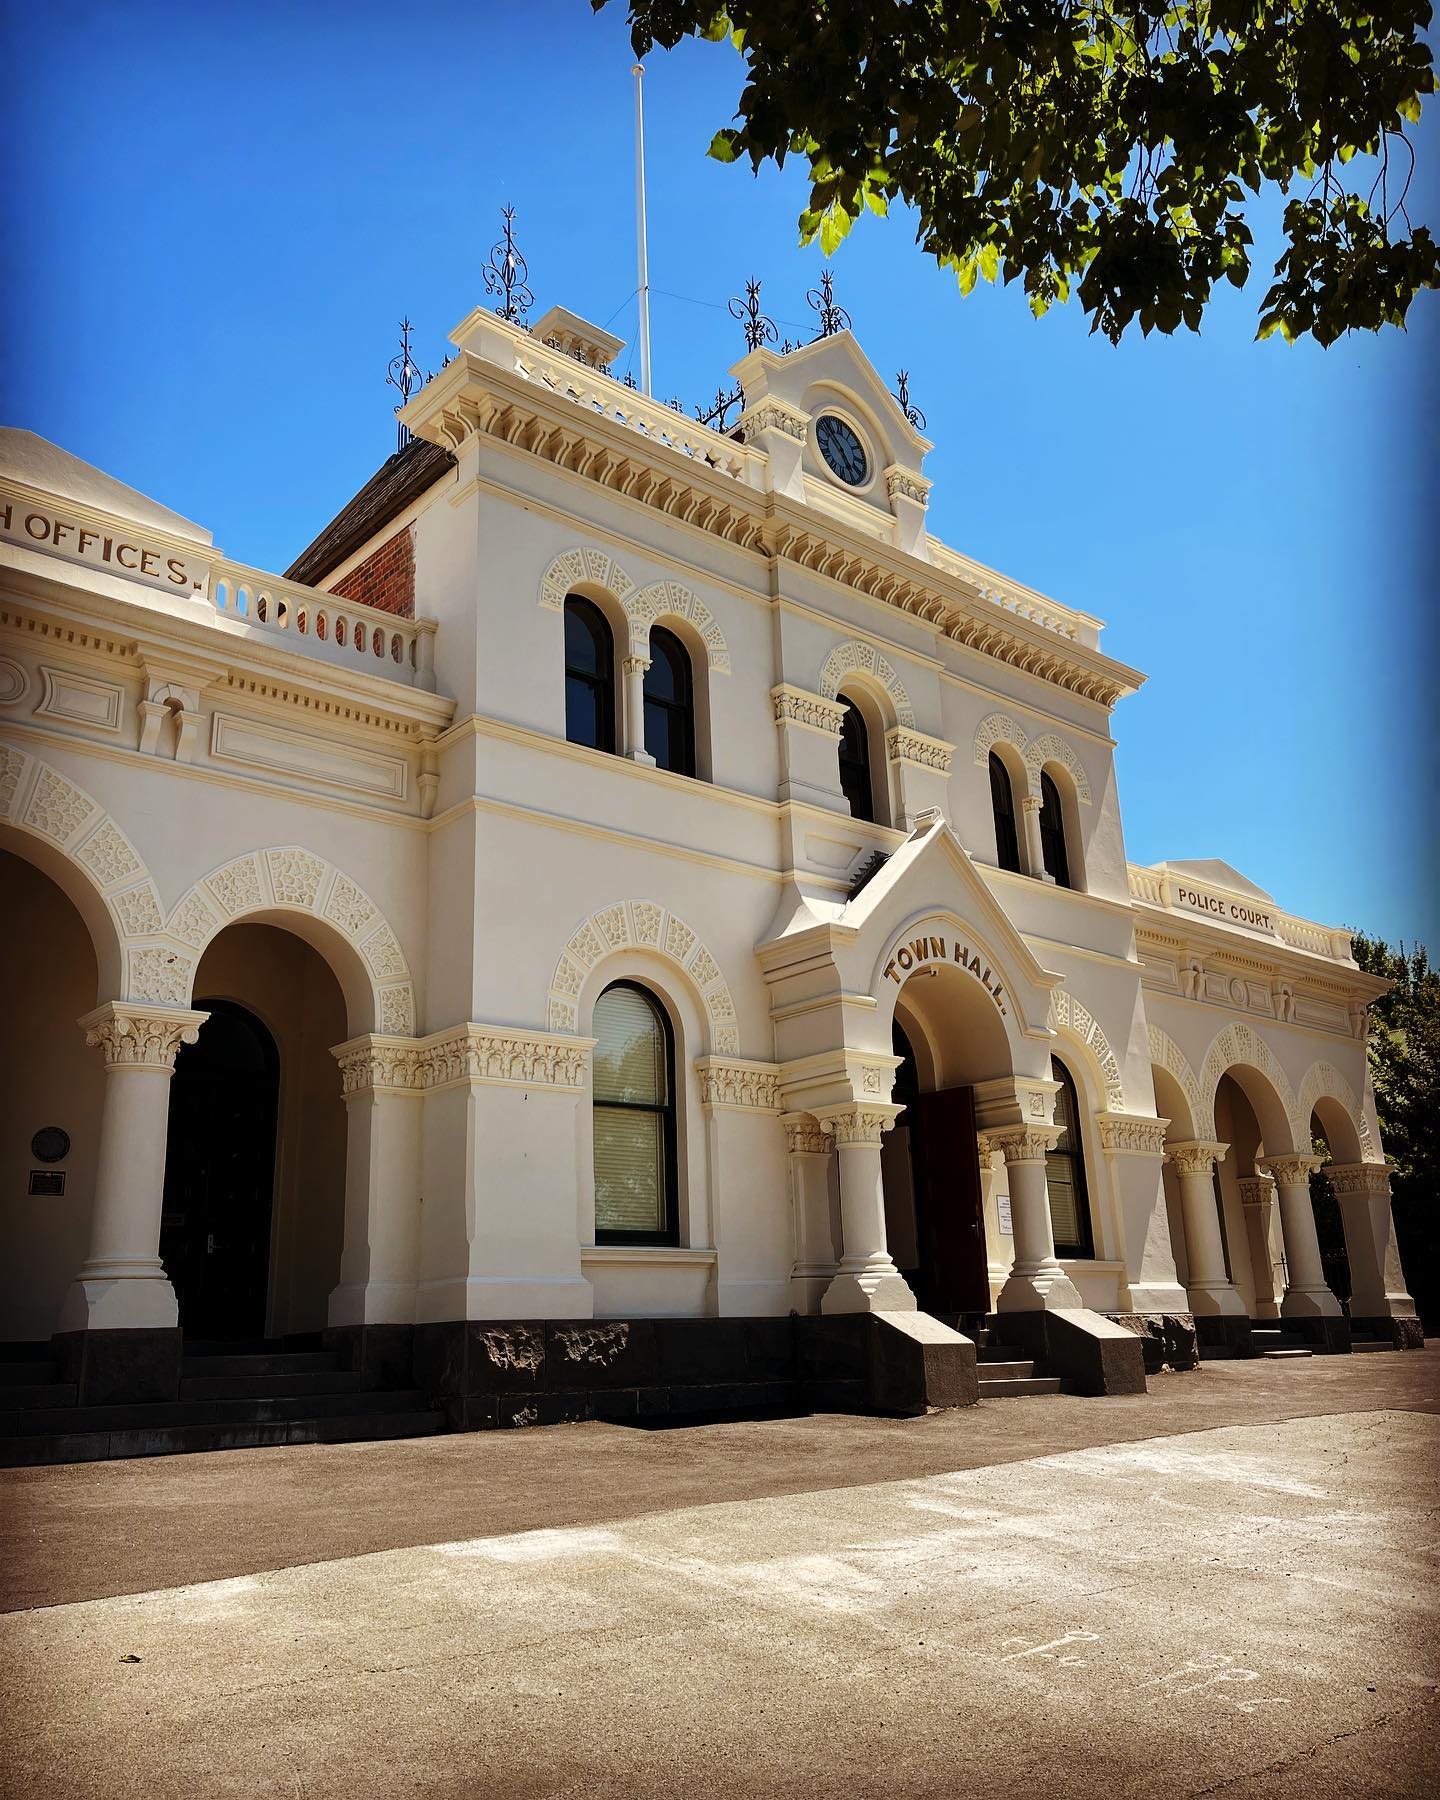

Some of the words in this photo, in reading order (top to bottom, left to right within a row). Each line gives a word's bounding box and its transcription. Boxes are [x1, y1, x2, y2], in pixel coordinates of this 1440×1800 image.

[24, 513, 202, 590] OFFICES.
[1178, 888, 1226, 915] POLICE
[1230, 905, 1274, 930] COURT.
[883, 936, 946, 984] TOWN
[954, 942, 1007, 1015] HALL.
